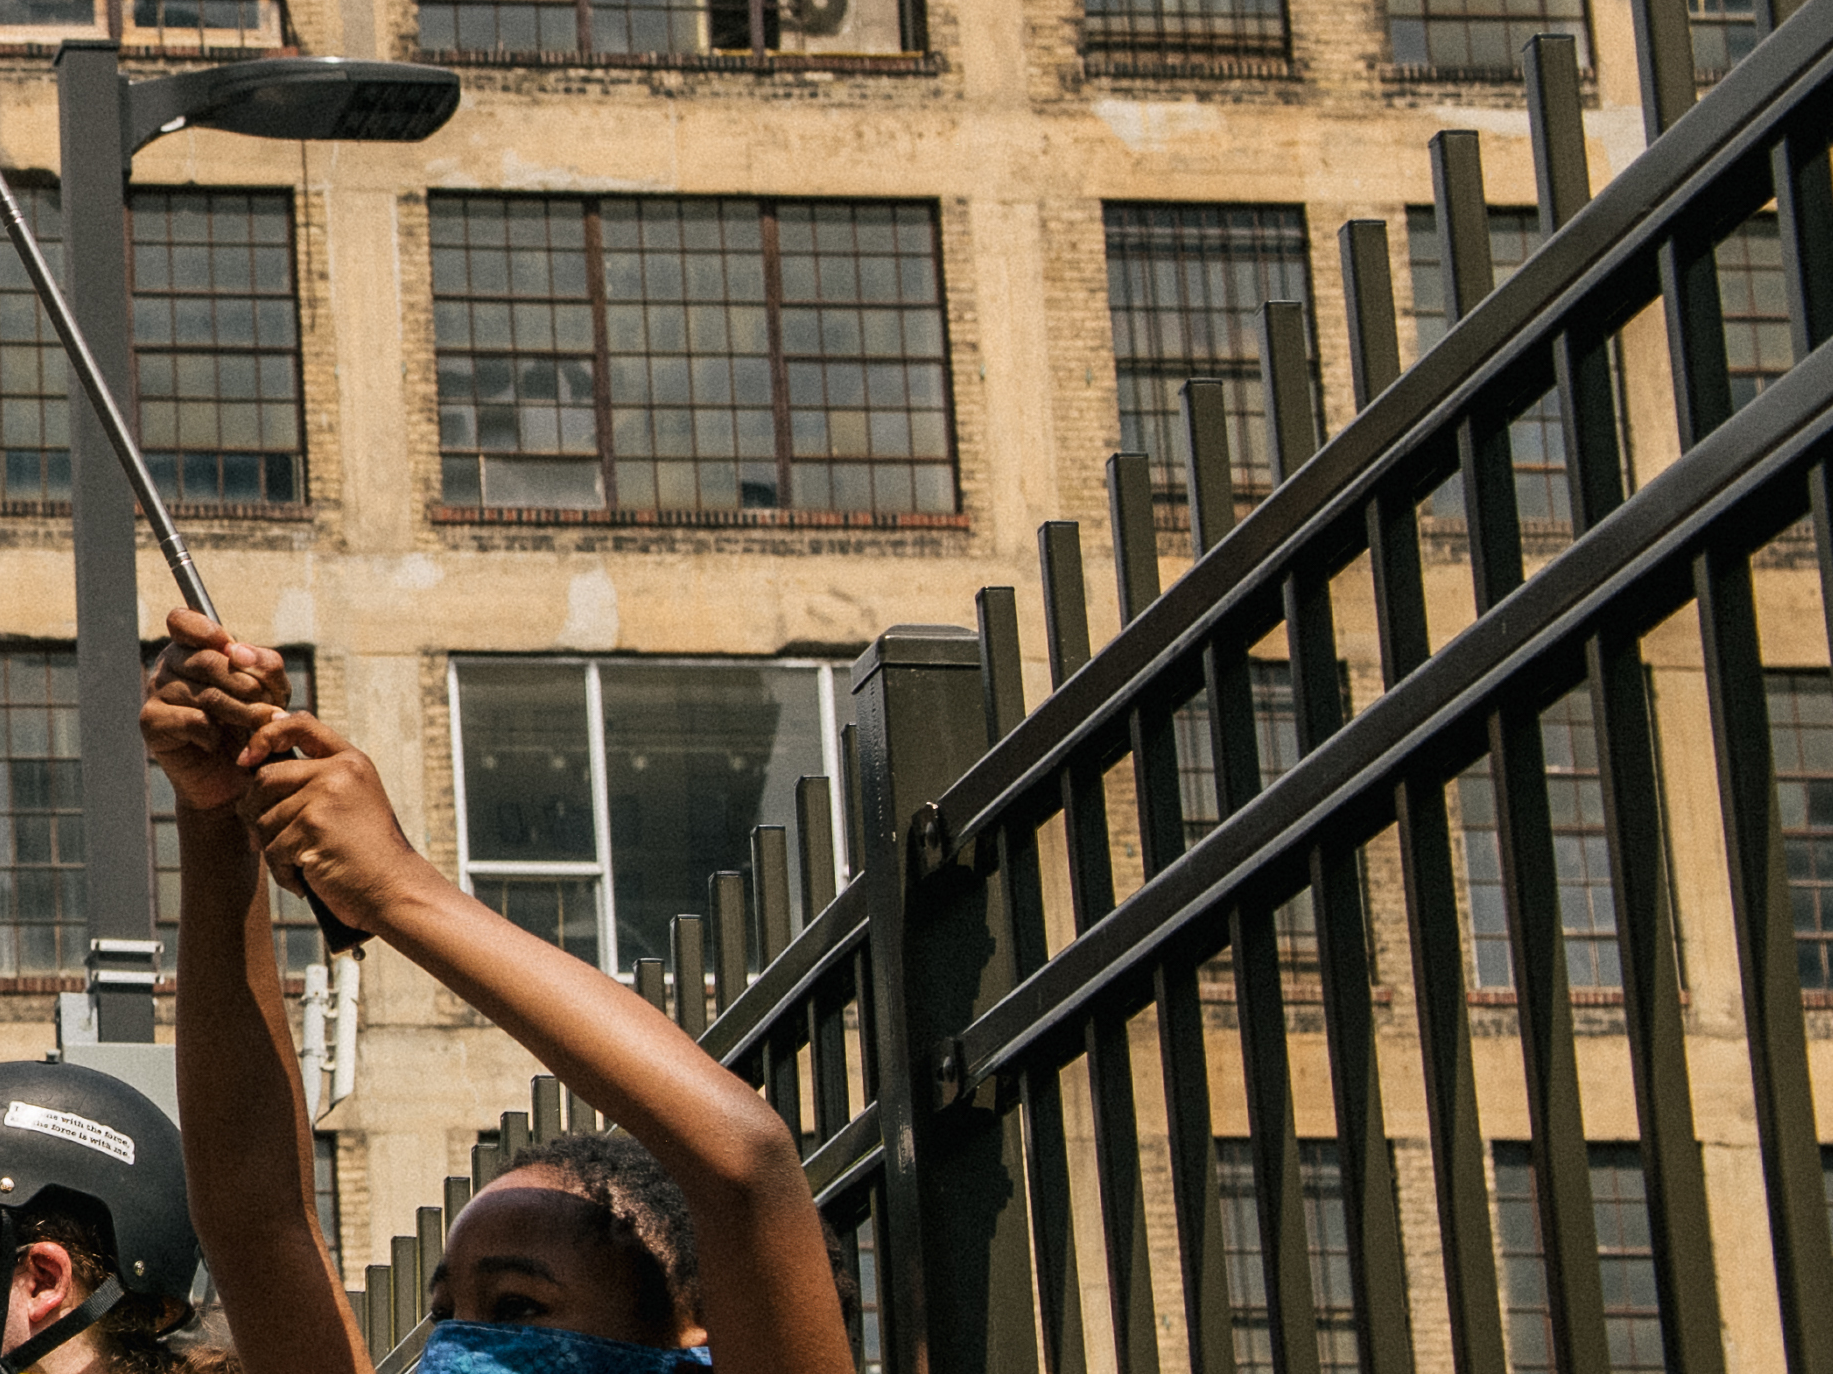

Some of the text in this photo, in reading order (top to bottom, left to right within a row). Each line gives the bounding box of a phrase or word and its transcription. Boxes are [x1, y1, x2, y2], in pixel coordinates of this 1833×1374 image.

[61, 1116, 84, 1129] with
[86, 1122, 103, 1135] the
[50, 1124, 77, 1137] force
[90, 1136, 112, 1151] with
